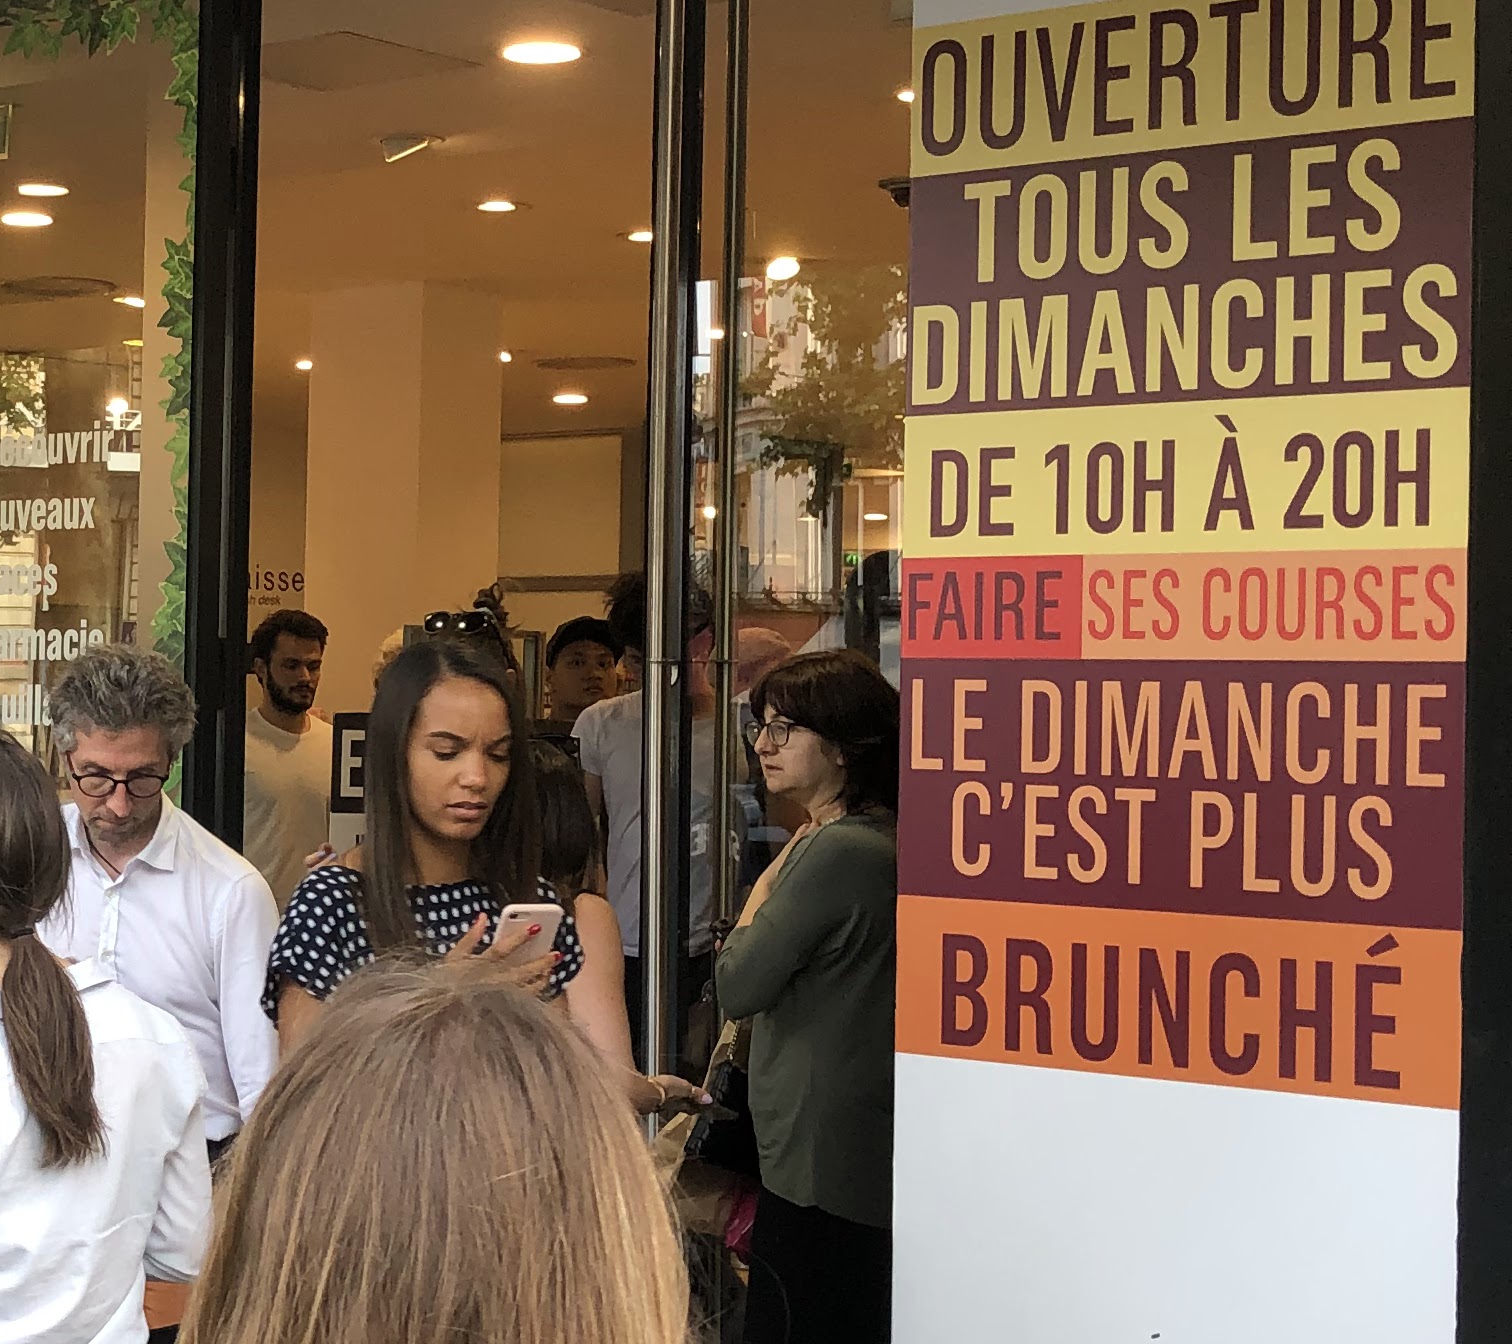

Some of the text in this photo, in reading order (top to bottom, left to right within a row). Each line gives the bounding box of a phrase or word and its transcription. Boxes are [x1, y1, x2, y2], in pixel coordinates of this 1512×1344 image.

[964, 138, 1402, 283] TOUS LES
[911, 263, 1459, 406] DIMANCHES
[929, 414, 1432, 538] DE 10H À 20H
[248, 563, 305, 592] isse
[258, 595, 281, 606] desk
[906, 564, 1456, 642] FAIRE SES COURSES
[910, 678, 1447, 788] LE DIMANCHE
[951, 781, 1393, 901] C'EST PLUS
[940, 932, 1402, 1090] BRUNCHÉ
